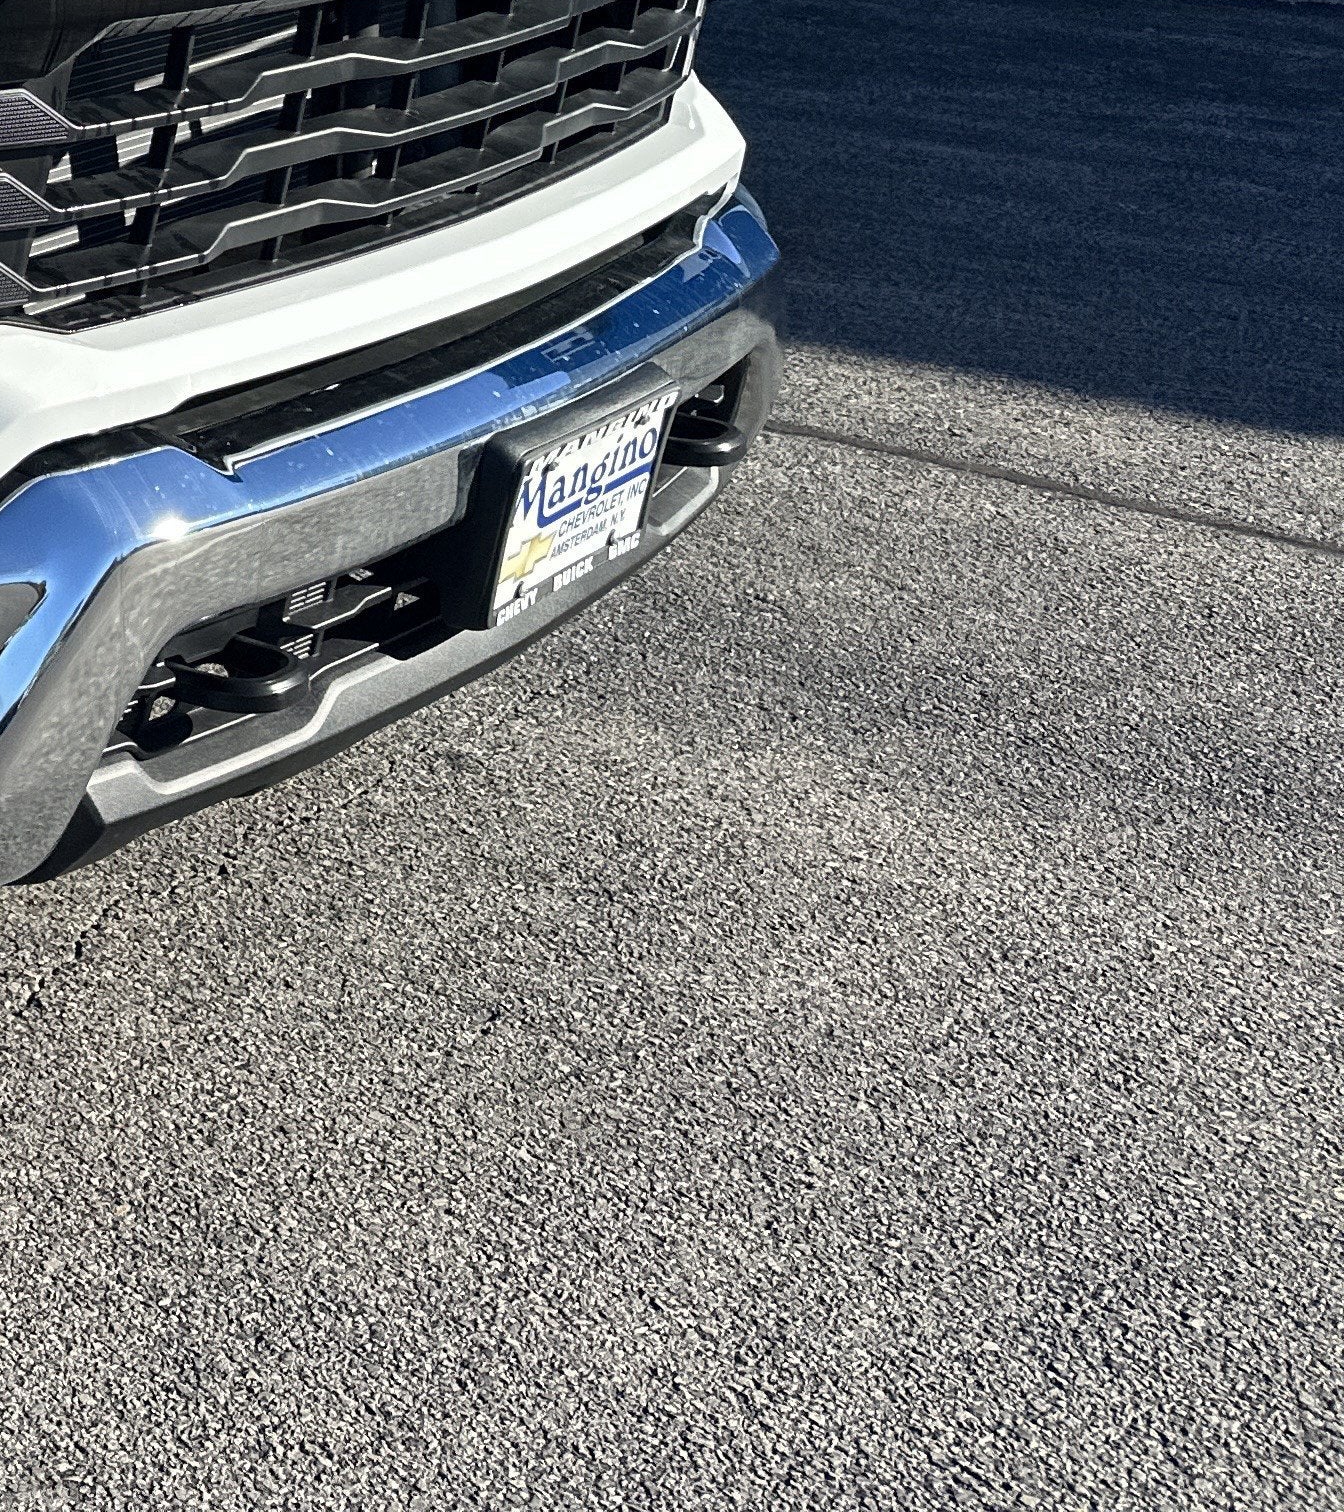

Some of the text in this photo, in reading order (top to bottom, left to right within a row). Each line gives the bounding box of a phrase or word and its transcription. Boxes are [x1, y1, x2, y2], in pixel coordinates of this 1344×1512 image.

[515, 427, 658, 529] Mangino
[496, 532, 641, 627] CHEVY BUICK GMC
